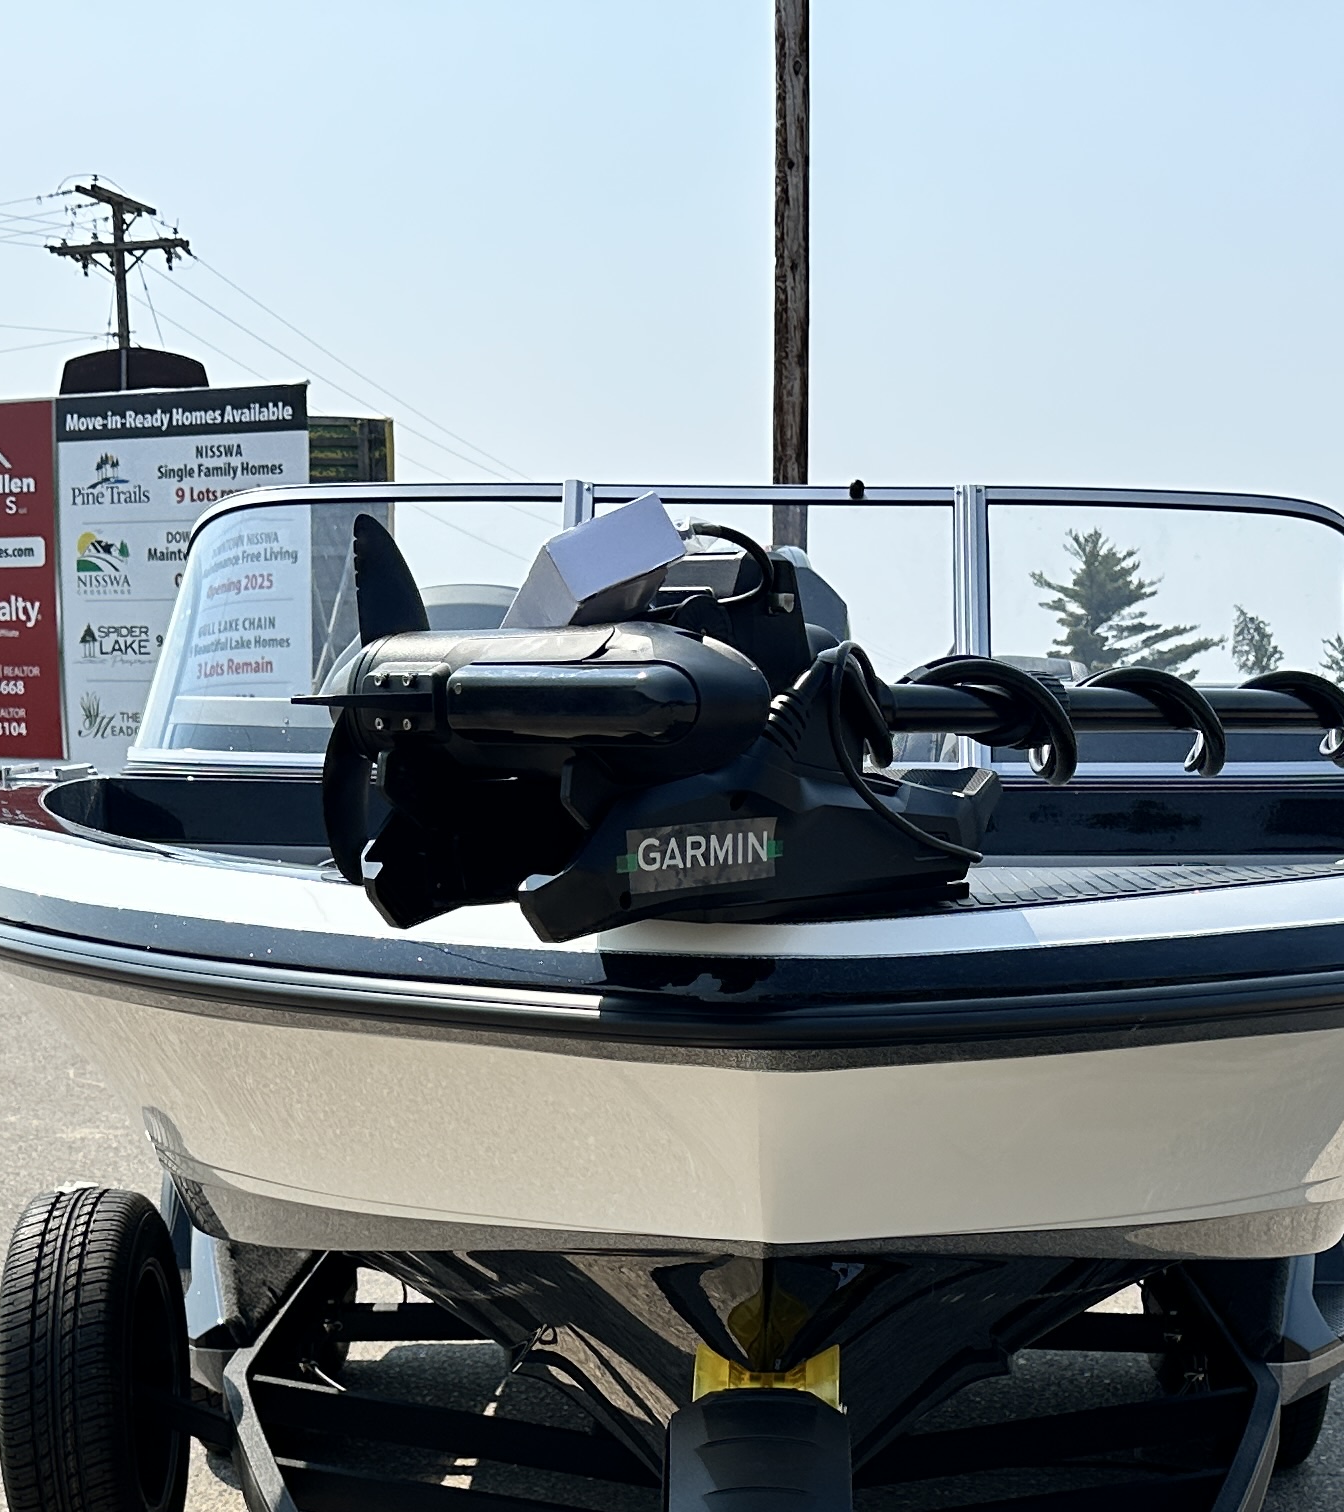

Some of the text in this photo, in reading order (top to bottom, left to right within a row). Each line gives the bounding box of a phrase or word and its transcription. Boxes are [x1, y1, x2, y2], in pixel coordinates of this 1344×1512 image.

[65, 402, 293, 432] Move-in-Ready Homes Available
[195, 444, 243, 459] NISSWA
[157, 462, 283, 482] Single Family Homes
[71, 484, 150, 506] Pine Trails
[175, 487, 185, 504] 9
[190, 486, 218, 503] Lots
[242, 550, 261, 564] Free
[264, 547, 298, 564] Living
[77, 574, 131, 588] NISSWA
[243, 573, 273, 591] 2025
[98, 626, 149, 638] SPIDER
[218, 618, 240, 634] LAKE
[242, 616, 276, 631] CHAIN
[99, 640, 151, 655] LAKE
[229, 636, 252, 650] Lake
[254, 635, 291, 649] Homes
[4, 666, 40, 676] REALTOR
[203, 661, 225, 678] Lots
[227, 656, 273, 676] Remain
[120, 712, 142, 723] THE
[638, 831, 768, 872] GARMIN
